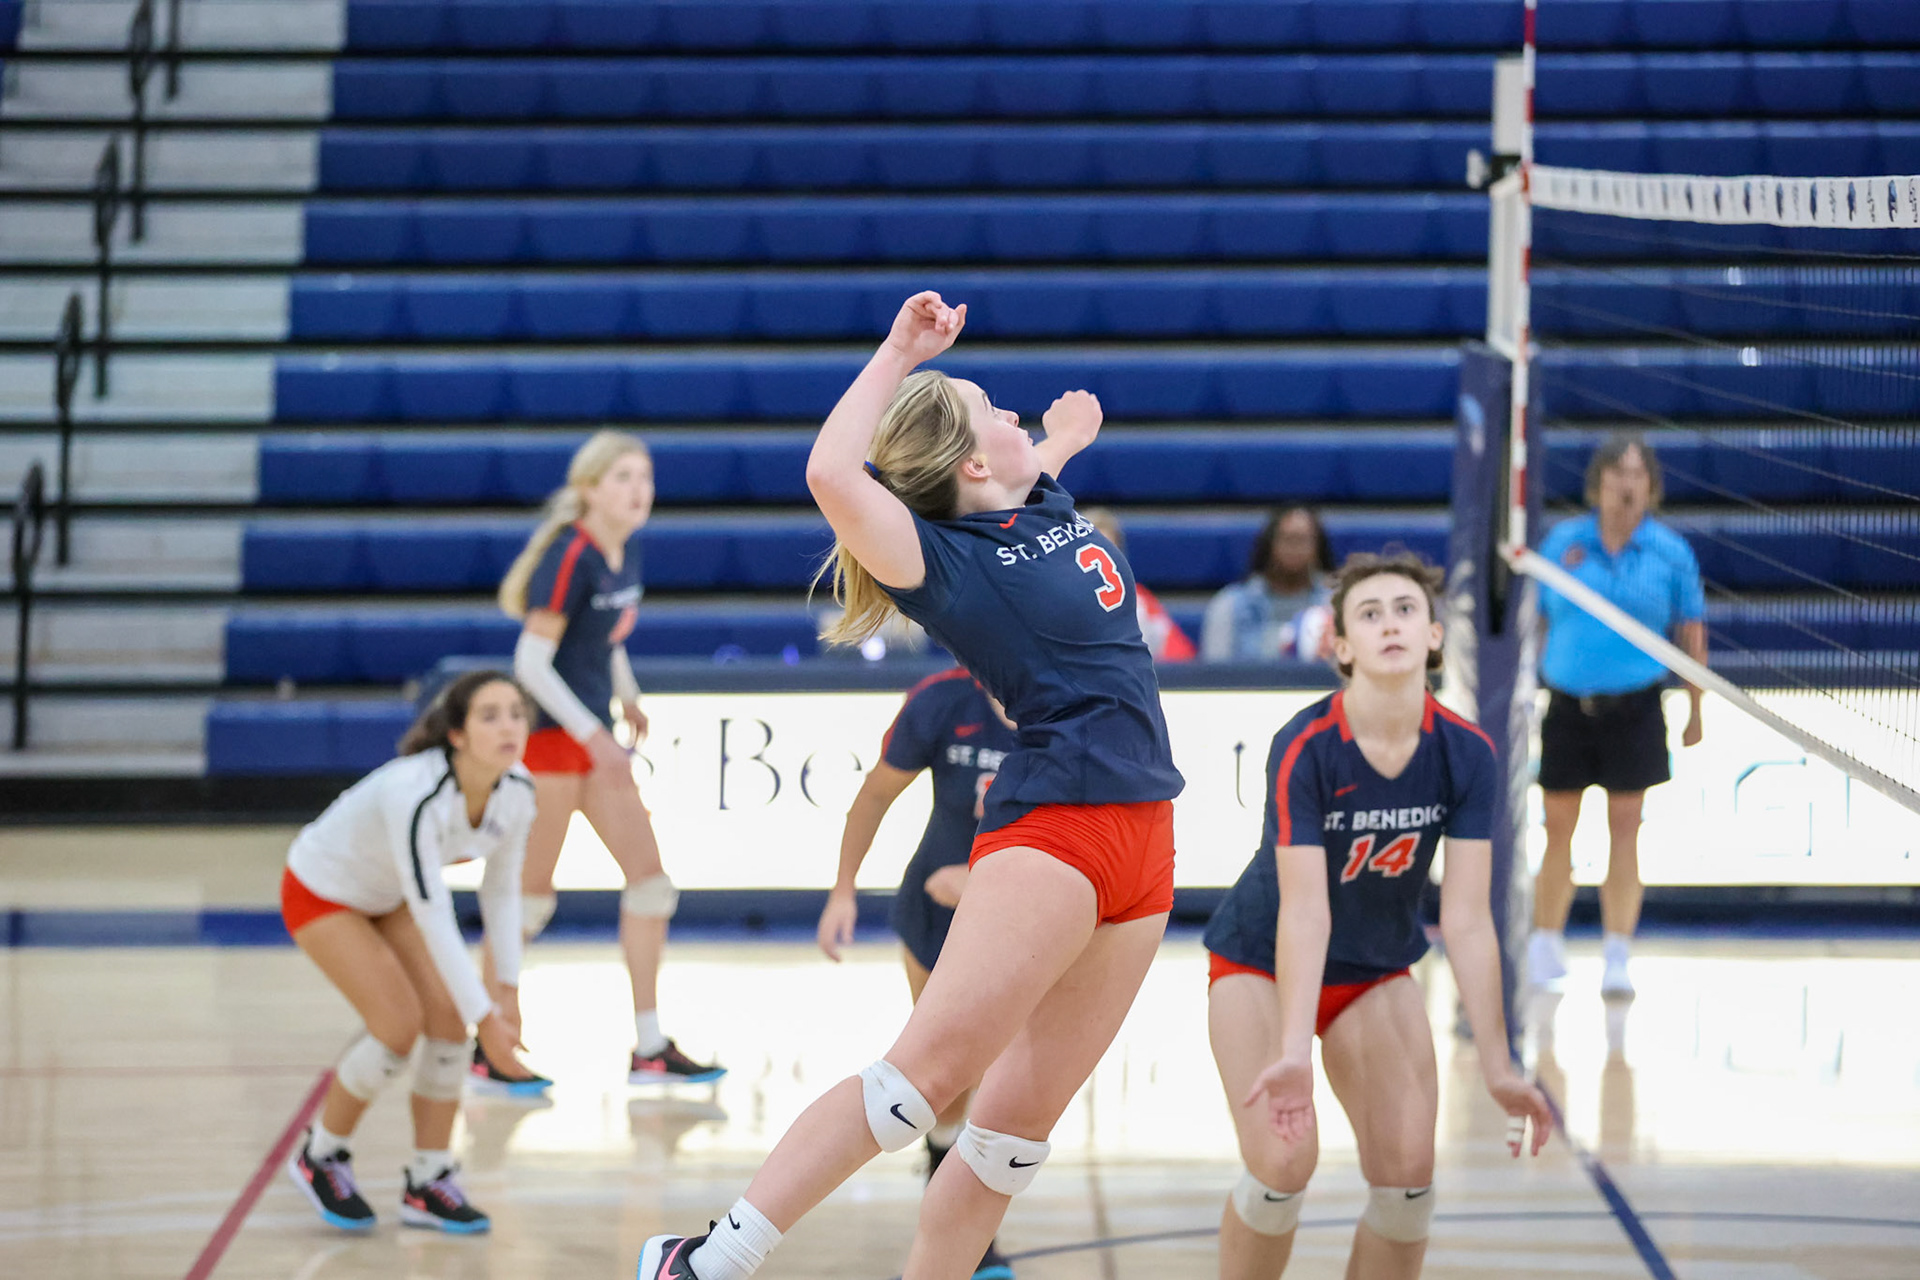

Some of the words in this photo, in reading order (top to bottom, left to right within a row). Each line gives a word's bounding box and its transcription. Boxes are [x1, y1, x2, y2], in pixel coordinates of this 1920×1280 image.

[996, 544, 1038, 566] ST.
[1075, 543, 1126, 613] 3
[1352, 803, 1448, 831] BENEDIC
[1340, 831, 1422, 885] 14
